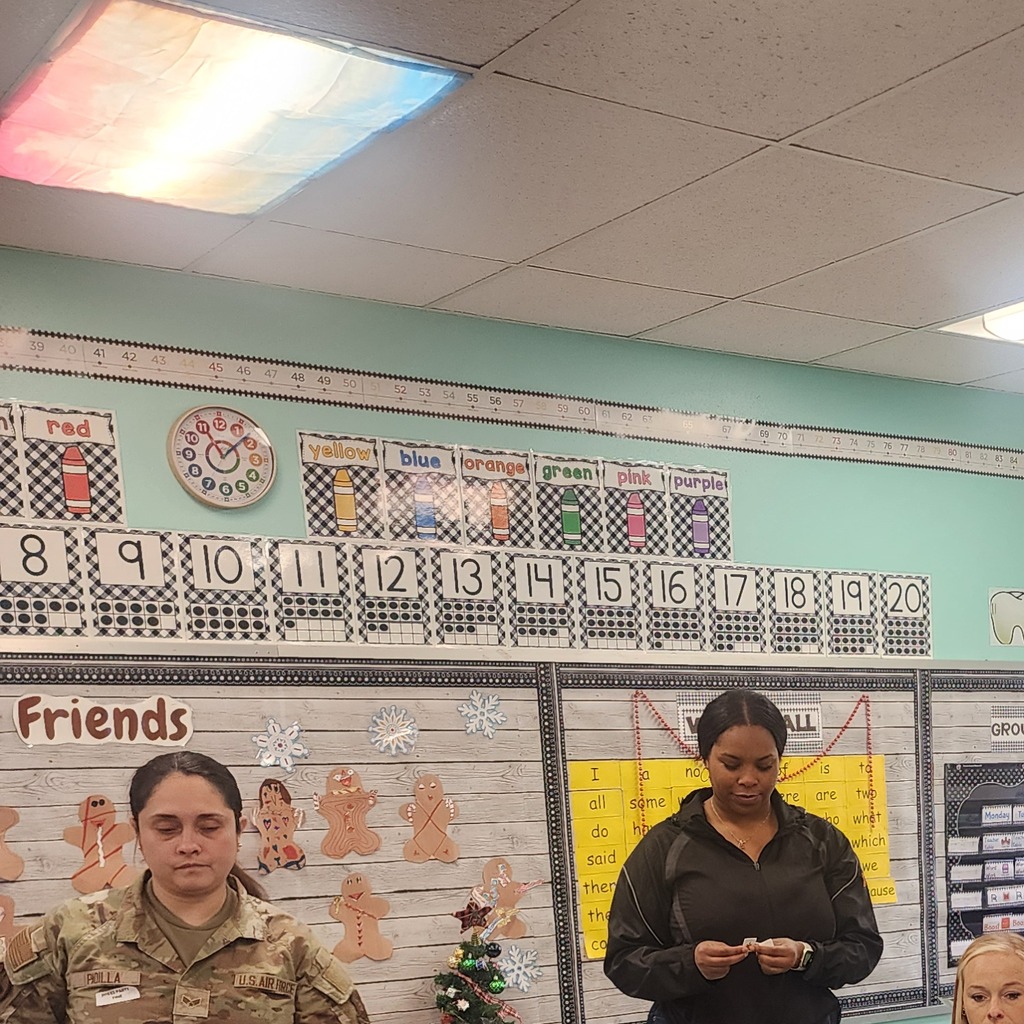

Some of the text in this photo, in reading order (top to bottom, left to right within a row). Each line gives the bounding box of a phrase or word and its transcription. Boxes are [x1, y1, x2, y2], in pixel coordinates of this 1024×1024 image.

[29, 341, 45, 351] 39
[93, 349, 106, 359] 41
[121, 352, 137, 362] 42
[151, 355, 166, 365] 43
[208, 363, 223, 372] 45
[236, 366, 251, 376] 46
[264, 369, 277, 379] 47
[291, 372, 305, 382] 48
[317, 376, 331, 386] 49
[343, 379, 357, 389] 50
[394, 385, 407, 395] 52
[418, 388, 431, 397] 53
[442, 391, 455, 400] 54
[466, 394, 479, 403] 55
[489, 397, 502, 406] 56
[513, 400, 524, 408] 57
[557, 404, 569, 413] 59
[578, 407, 591, 415] 60
[621, 413, 633, 421] 62
[721, 426, 732, 434] 67
[759, 430, 770, 439] 69
[777, 432, 788, 440] 70
[832, 437, 841, 445] 73
[849, 438, 859, 447] 74
[883, 442, 893, 450] 76
[900, 443, 909, 452] 77
[948, 448, 957, 457] 80
[1009, 456, 1018, 464] 84
[46, 419, 91, 438] red
[308, 441, 371, 463] yellow
[399, 450, 442, 469] blue
[463, 457, 525, 478] orange
[542, 463, 593, 483] green
[617, 470, 652, 487] pink
[674, 474, 724, 493] purple
[19, 533, 922, 613] 8 9 10 11 12 13 14 15 16 17 18 19 20
[17, 697, 189, 742] Friends
[784, 714, 816, 732] ALL
[591, 767, 599, 781] I
[820, 762, 830, 774] is
[815, 791, 838, 801] are
[856, 788, 877, 800] two
[589, 795, 606, 810] all
[630, 797, 666, 809] some
[824, 812, 840, 825] ho
[853, 811, 882, 824] what
[985, 811, 1010, 819] Monday
[591, 824, 609, 838] do
[851, 833, 886, 848] which
[587, 850, 616, 866] said
[862, 862, 878, 871] we
[239, 975, 258, 987] U.S.
[259, 976, 275, 989] AIR
